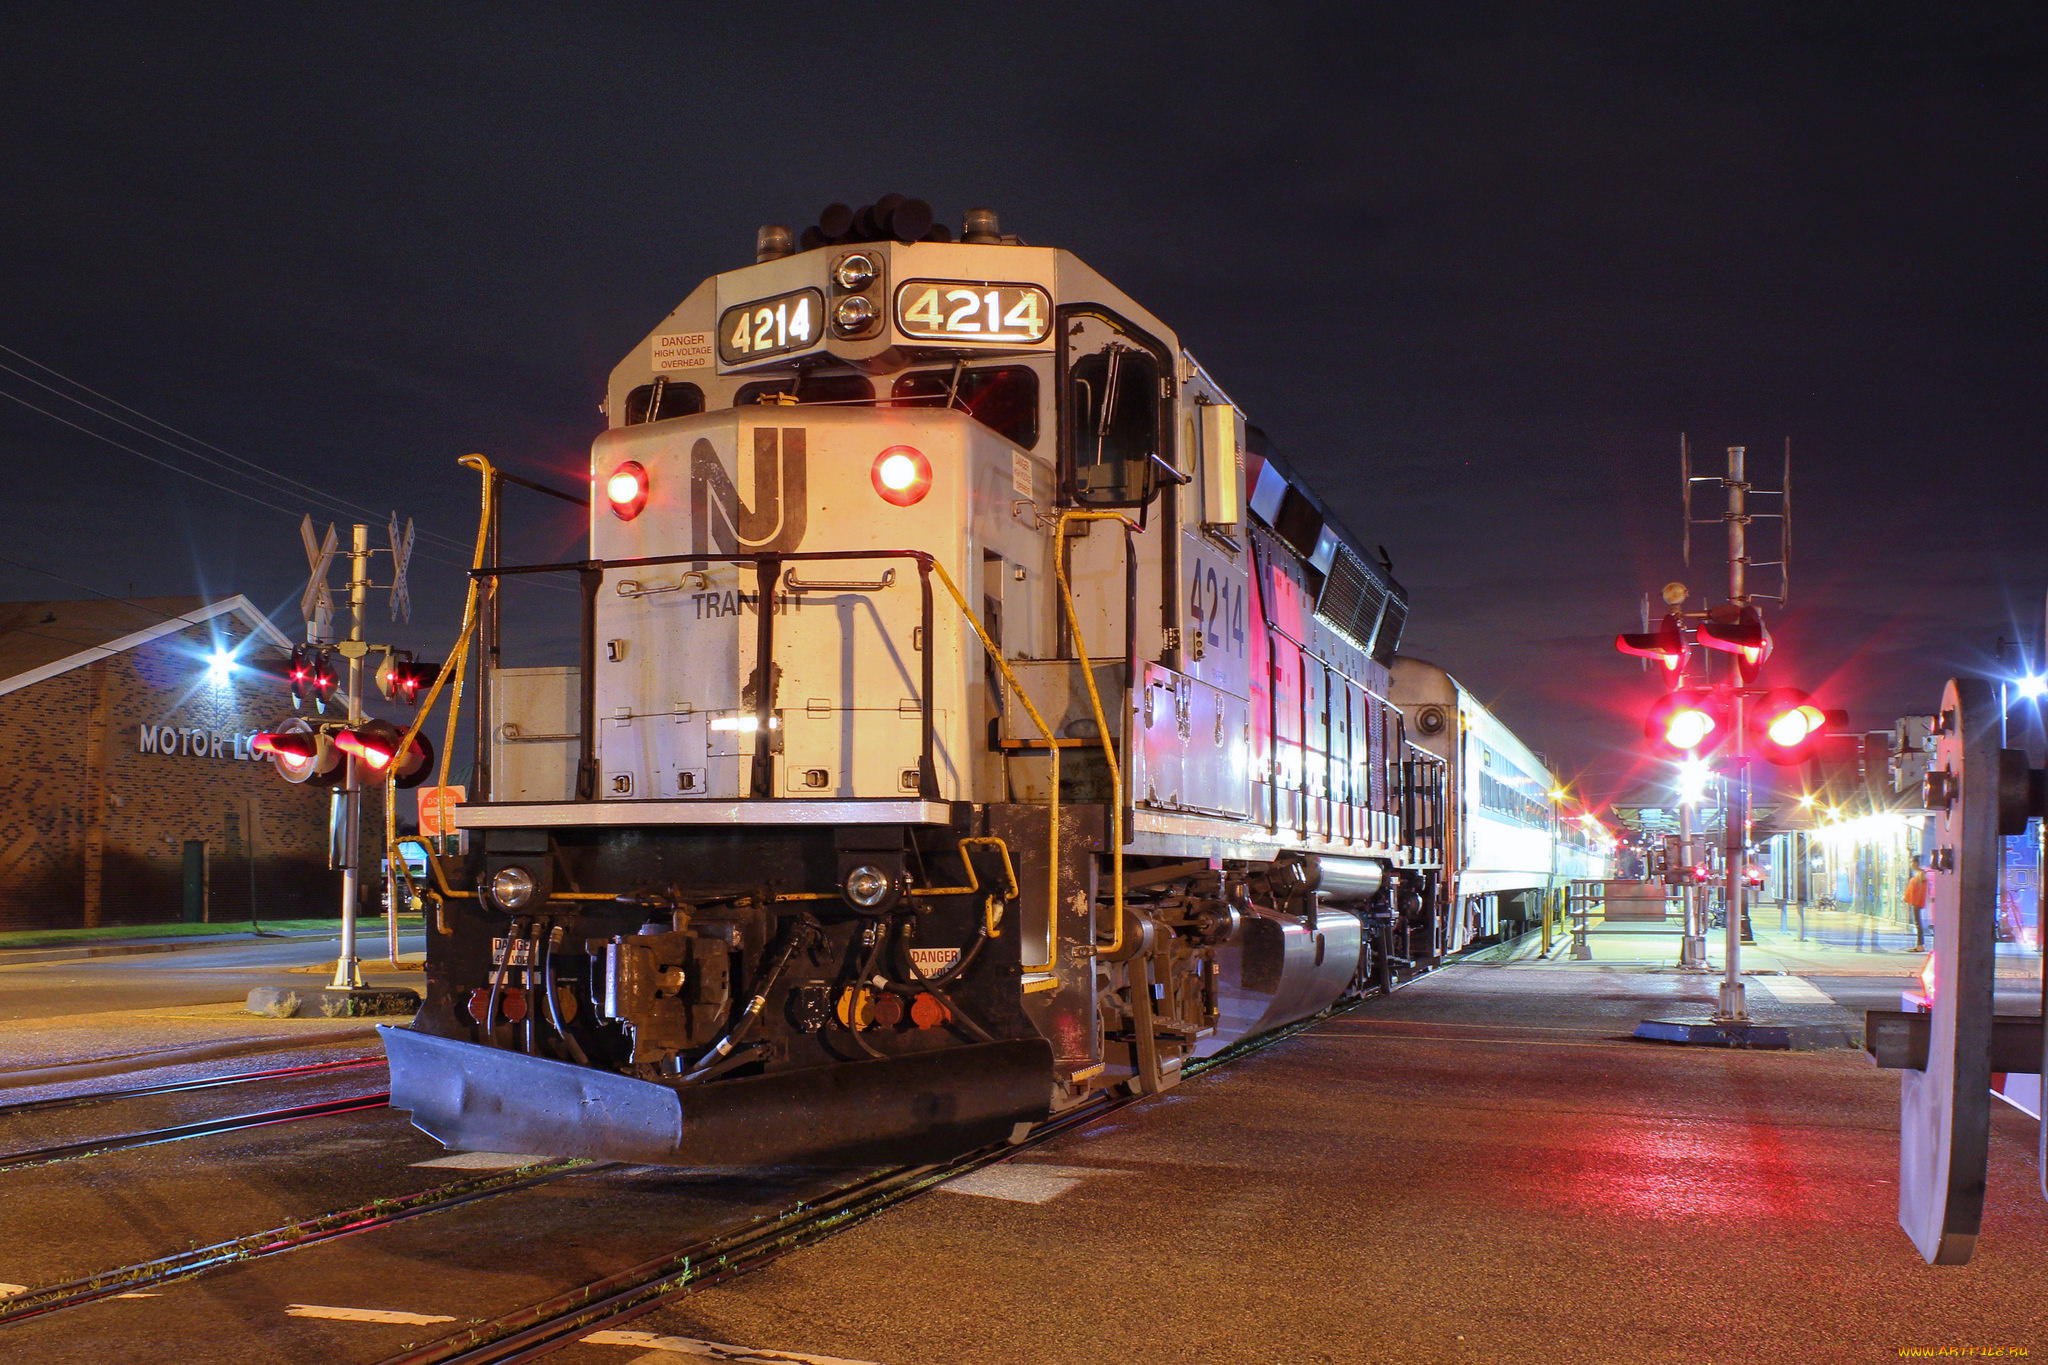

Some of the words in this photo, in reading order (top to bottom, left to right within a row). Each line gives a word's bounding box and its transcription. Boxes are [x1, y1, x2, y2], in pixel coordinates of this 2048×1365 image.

[904, 288, 1044, 332] 4214
[731, 298, 810, 353] 4214
[661, 334, 705, 347] DANGER
[654, 349, 675, 358] HIGH
[676, 346, 712, 356] VOLTAGE
[661, 358, 705, 369] OVERHEAD
[691, 427, 807, 570] NJ
[1191, 558, 1244, 659] 4214
[139, 723, 224, 759] MOTOR
[445, 796, 457, 804] OT
[494, 939, 531, 951] DAGE
[912, 950, 958, 963] DANGER
